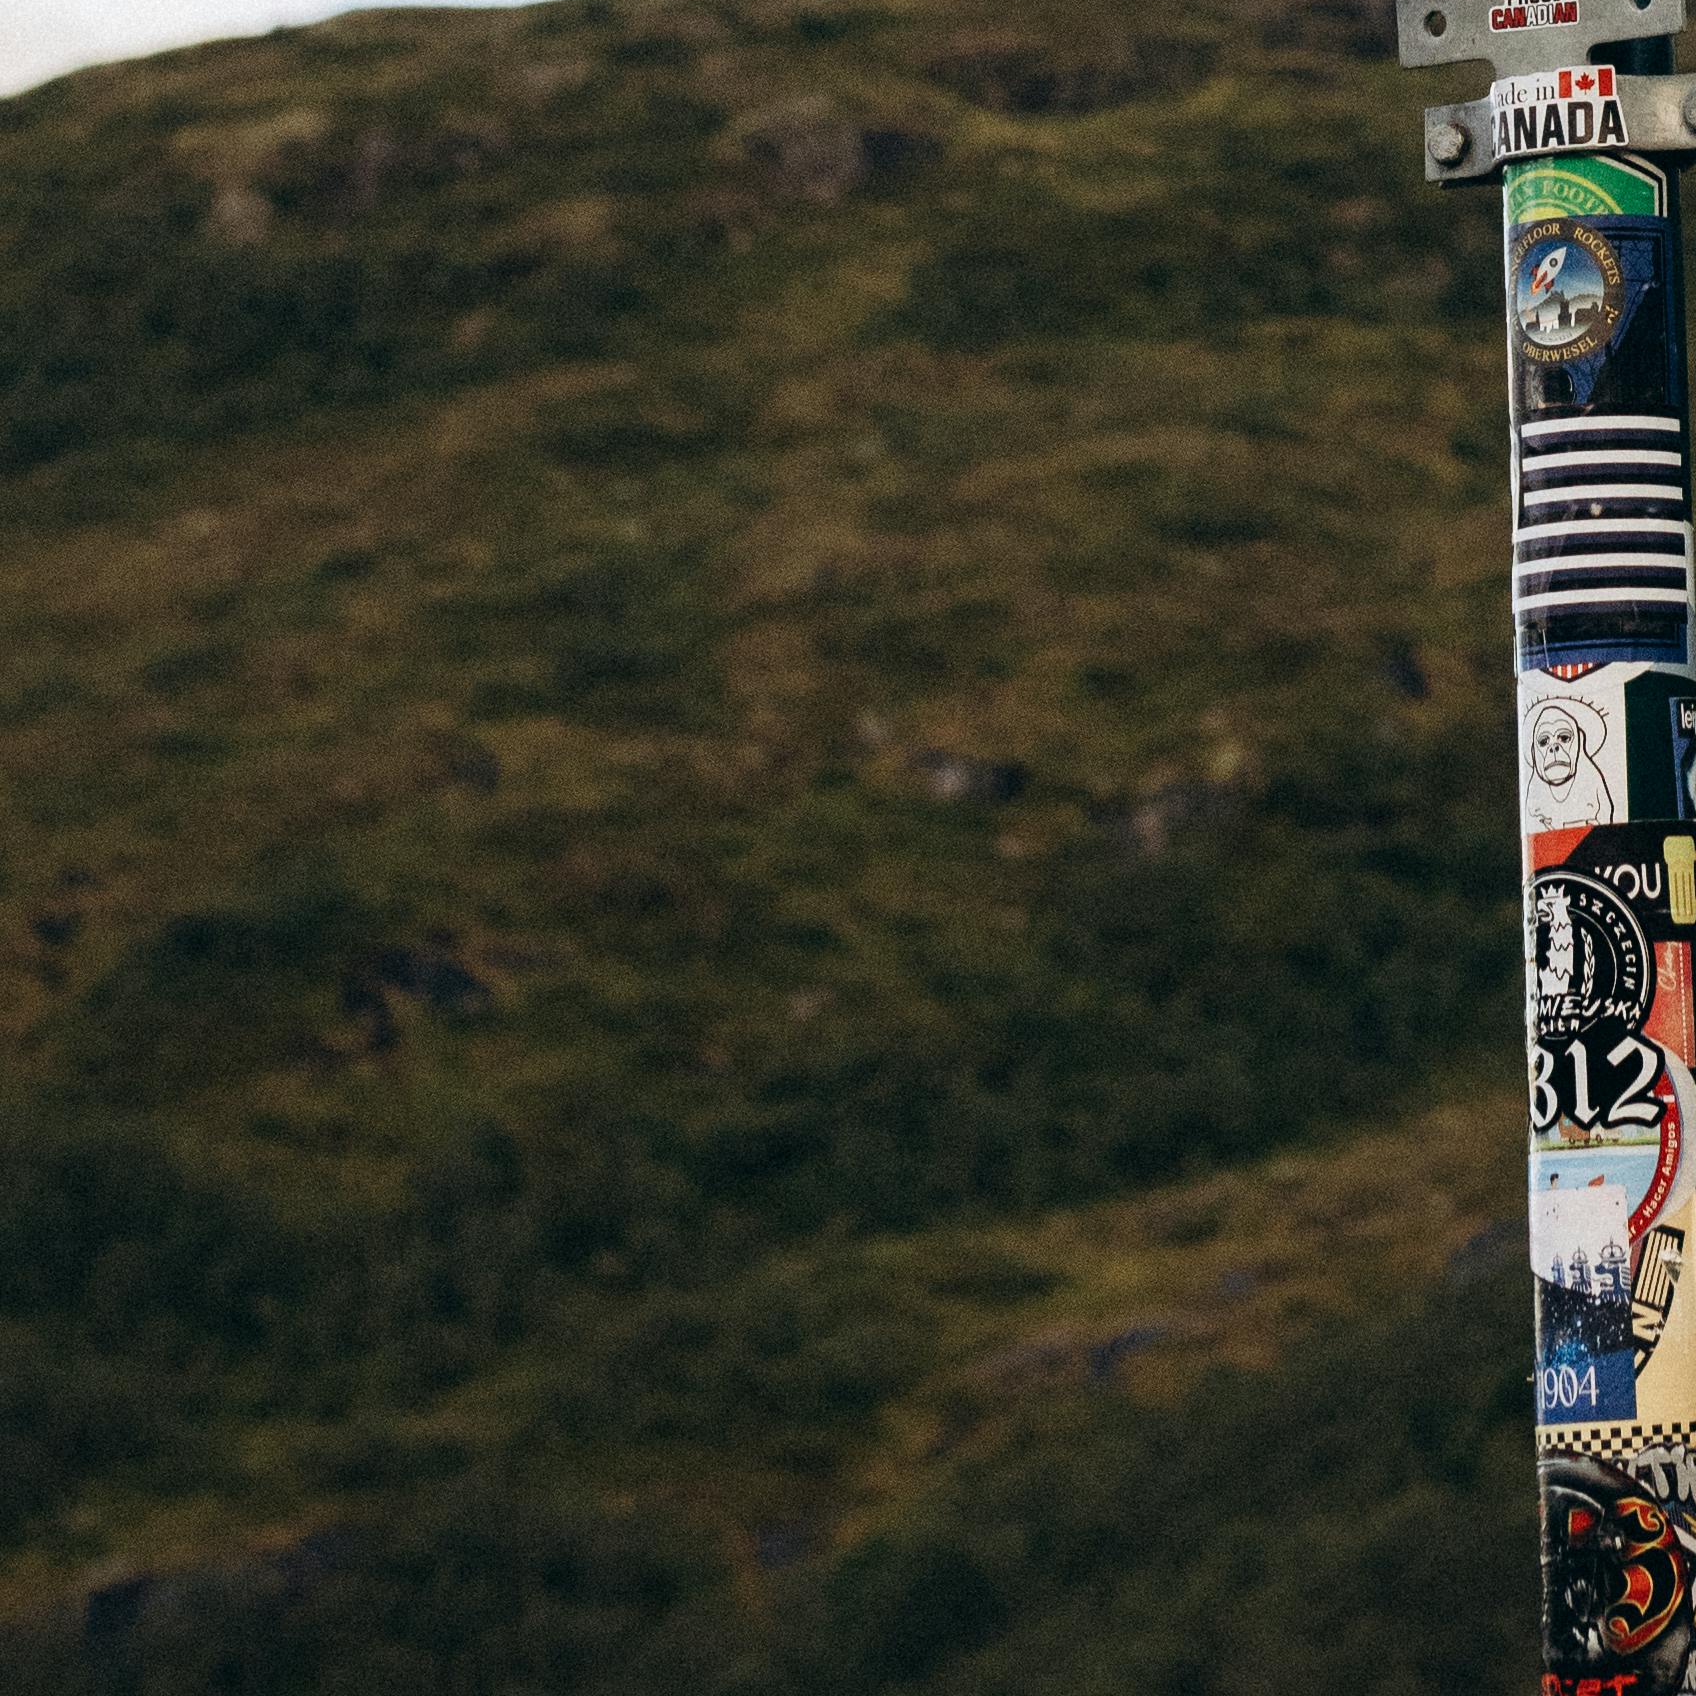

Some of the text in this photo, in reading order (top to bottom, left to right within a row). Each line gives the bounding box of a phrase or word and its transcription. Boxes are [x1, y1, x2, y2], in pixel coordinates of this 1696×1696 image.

[1491, 1, 1578, 30] CANADIAN
[1498, 78, 1555, 108] ade in
[1573, 227, 1621, 285] ROCKETS
[1522, 336, 1598, 362] OBERWESEL
[1579, 893, 1637, 991] SZCZECIN
[1643, 1122, 1678, 1217] Hacer Amigos
[1537, 1365, 1599, 1409] 1904
